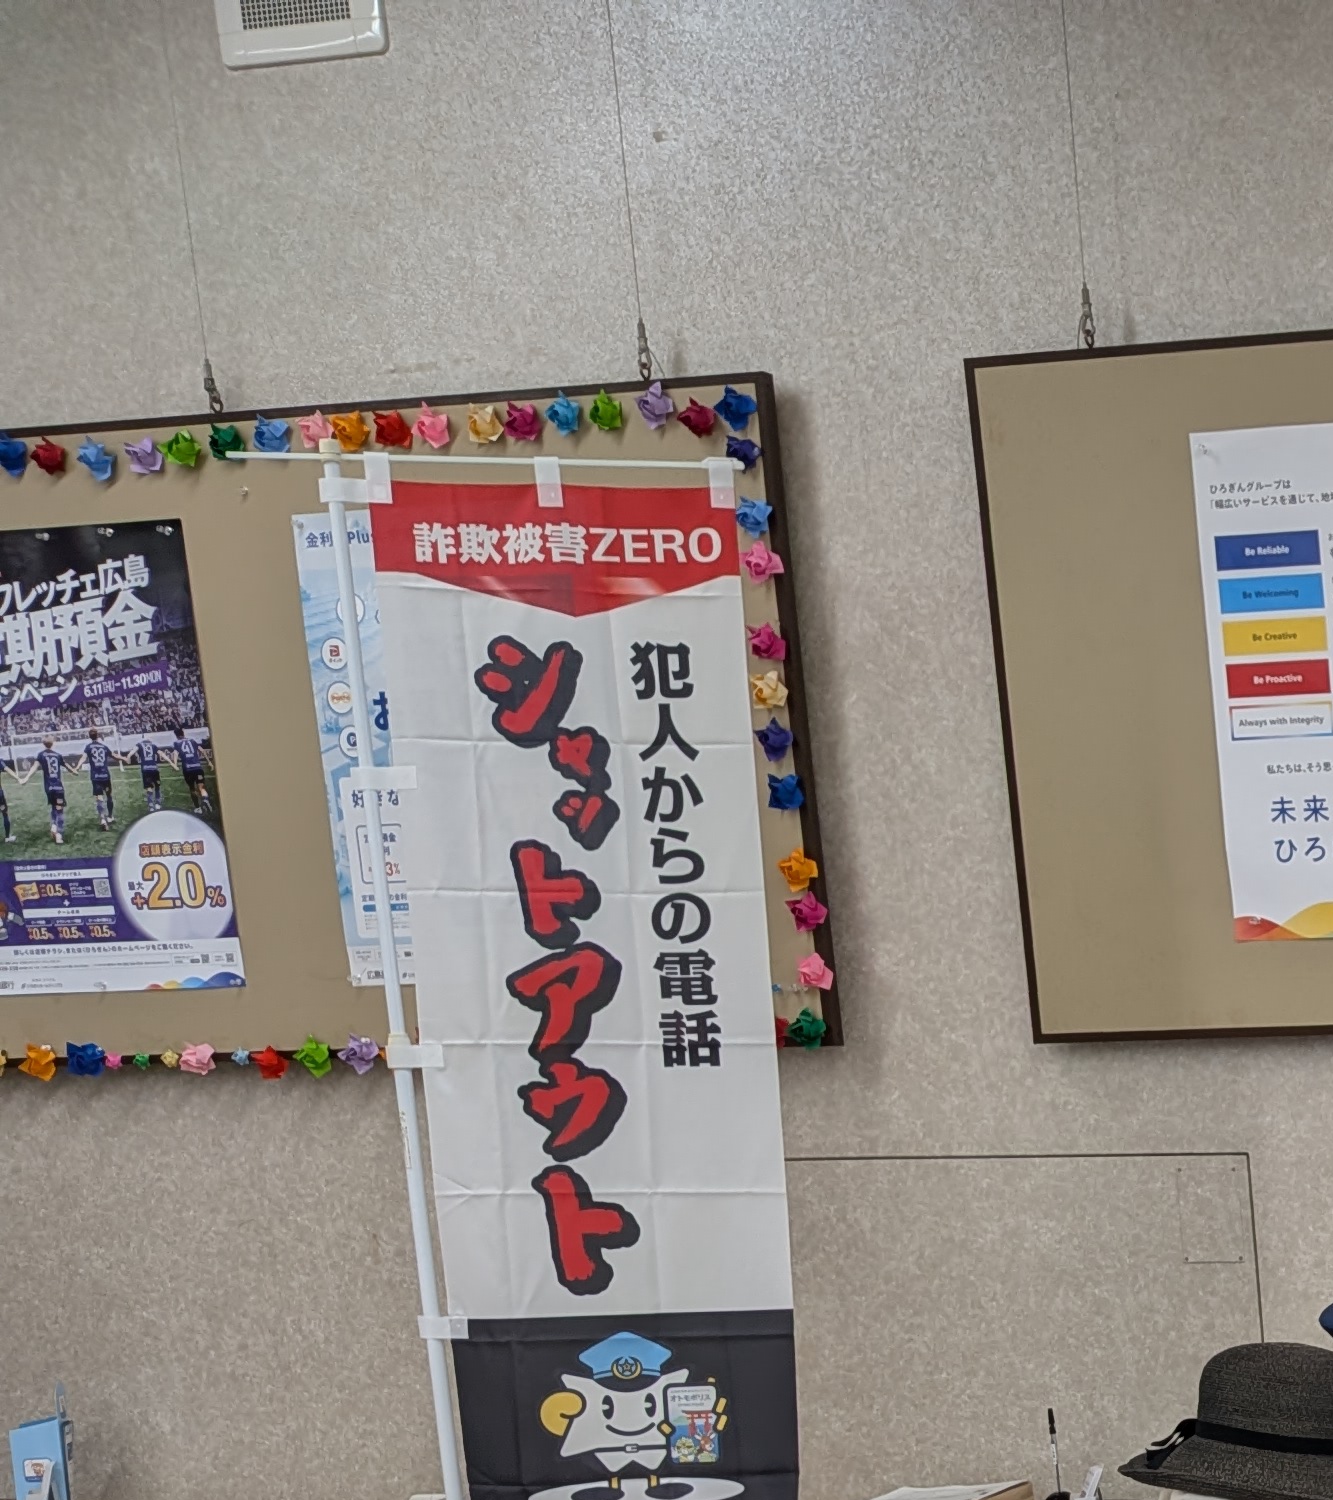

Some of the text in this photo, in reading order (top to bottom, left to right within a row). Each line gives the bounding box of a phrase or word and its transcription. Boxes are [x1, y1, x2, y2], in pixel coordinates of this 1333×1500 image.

[1209, 480, 1292, 494] ひろぎんグループは
[348, 530, 373, 545] Plu
[412, 521, 723, 566] 詐欺被害ZERO
[1244, 544, 1290, 556] Be Reliable
[1241, 587, 1299, 600] Be Welcoming
[0, 588, 160, 686] 期預金
[1251, 630, 1298, 642] Be Creative
[1253, 673, 1303, 685] Be Proactive
[1238, 714, 1325, 728] Always with Integrity
[629, 640, 722, 1068] 犯人からの電話
[474, 634, 641, 1296] シャットアウト
